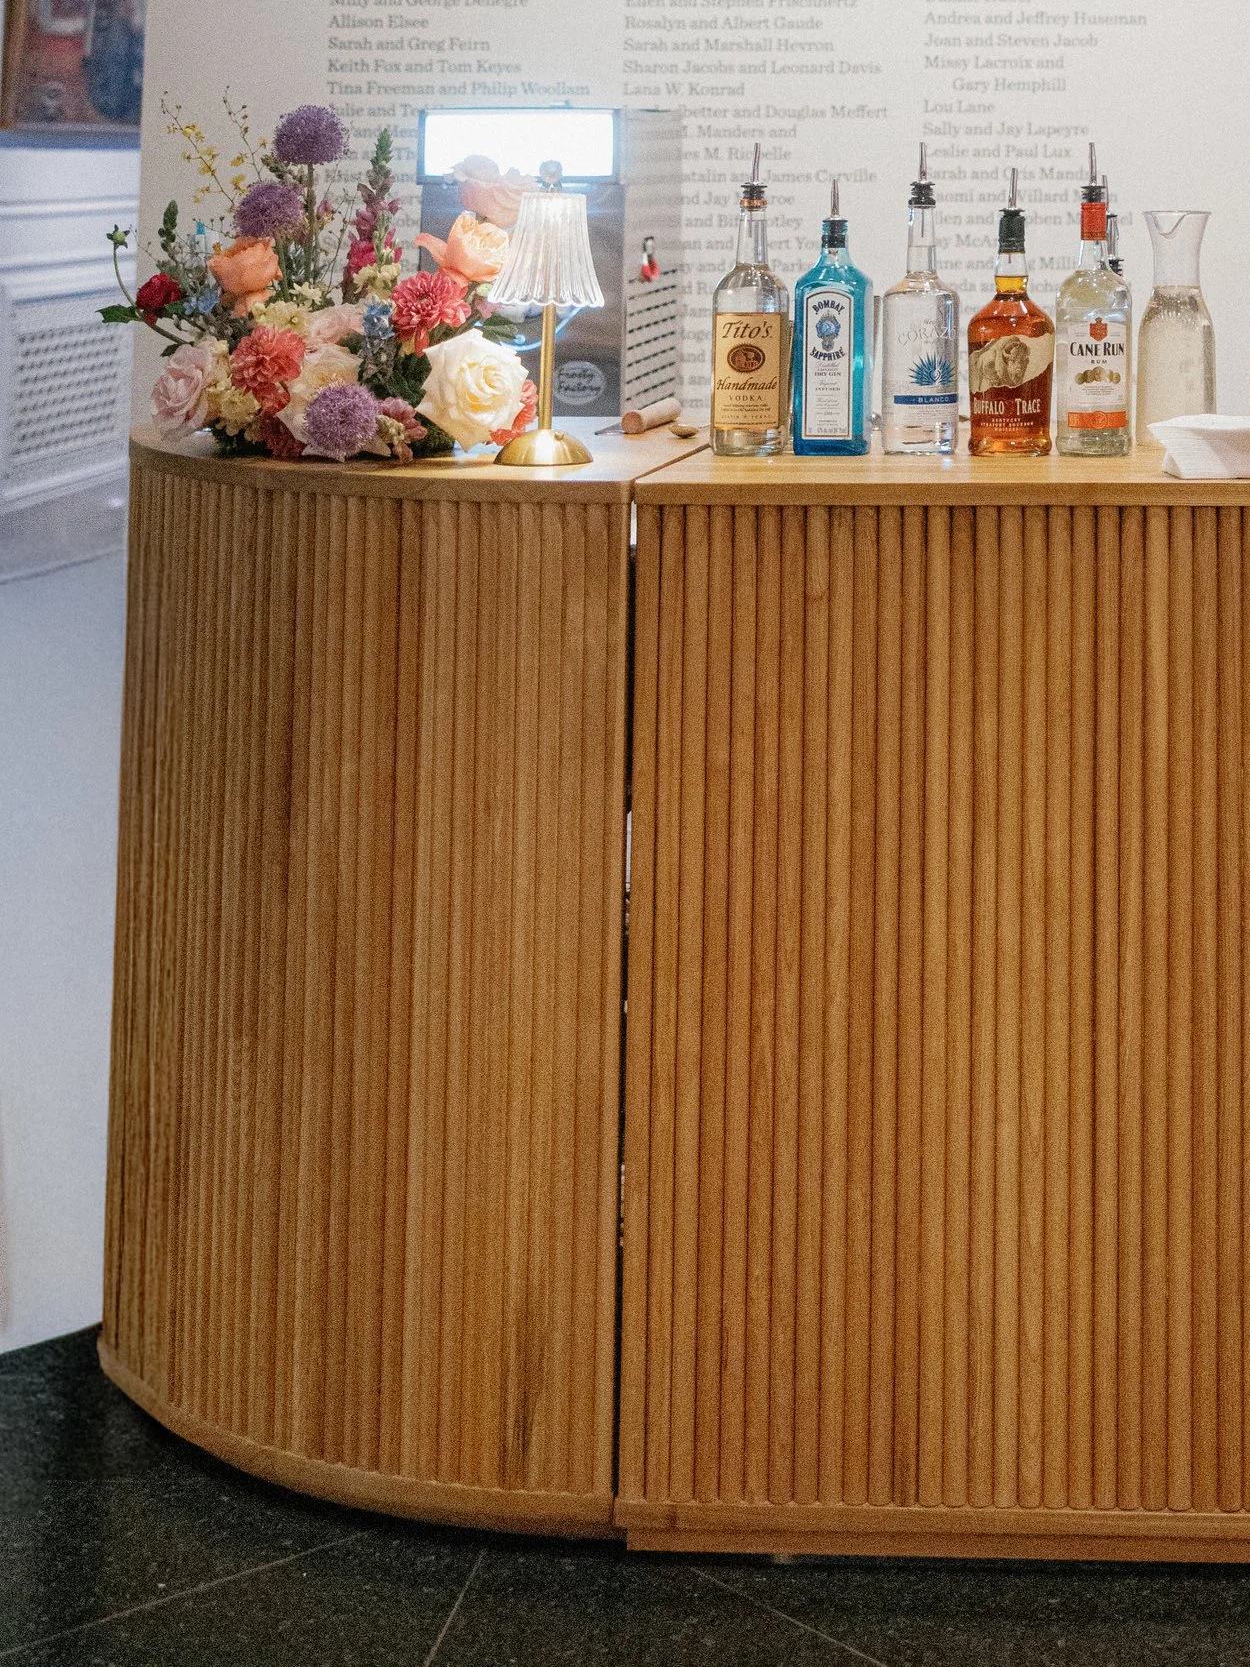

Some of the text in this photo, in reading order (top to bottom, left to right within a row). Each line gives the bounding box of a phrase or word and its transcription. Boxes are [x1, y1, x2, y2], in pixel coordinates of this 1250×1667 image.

[327, 38, 491, 55] Sarah and Greg Feirn
[326, 60, 522, 77] Keith Fox and Tom Keyes
[812, 299, 846, 315] BOMBAY
[722, 319, 773, 339] Tito's
[809, 346, 846, 361] SAPPHIRE
[1069, 341, 1125, 357] CANE RUN
[716, 376, 777, 391] Handmade
[973, 397, 1005, 415] BUFFALO
[1014, 398, 1041, 415] TRACE
